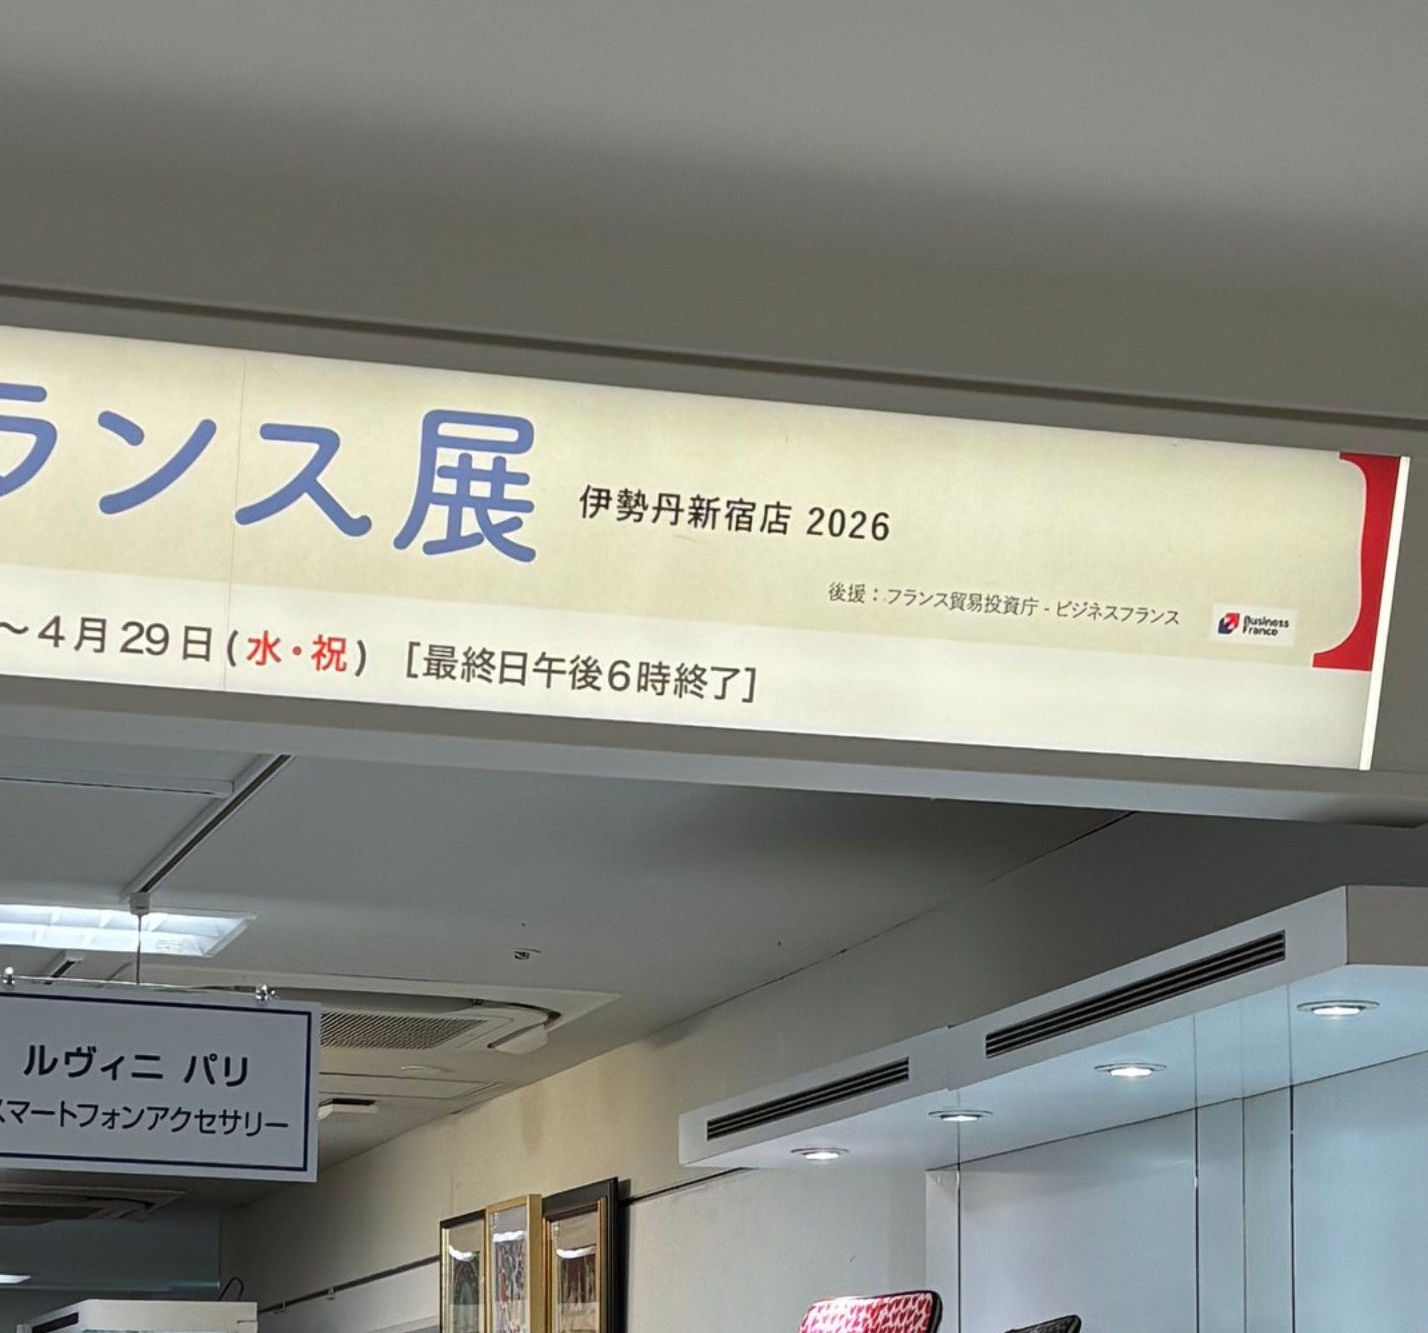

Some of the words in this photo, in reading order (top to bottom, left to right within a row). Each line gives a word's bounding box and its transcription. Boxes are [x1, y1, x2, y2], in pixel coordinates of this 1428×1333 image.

[578, 483, 792, 538] 伊勢丹新宿店
[806, 502, 891, 543] 2026
[1056, 599, 1180, 626] ビジネスフランス
[23, 1044, 163, 1080] ルヴィニ
[183, 1051, 250, 1088] パリ
